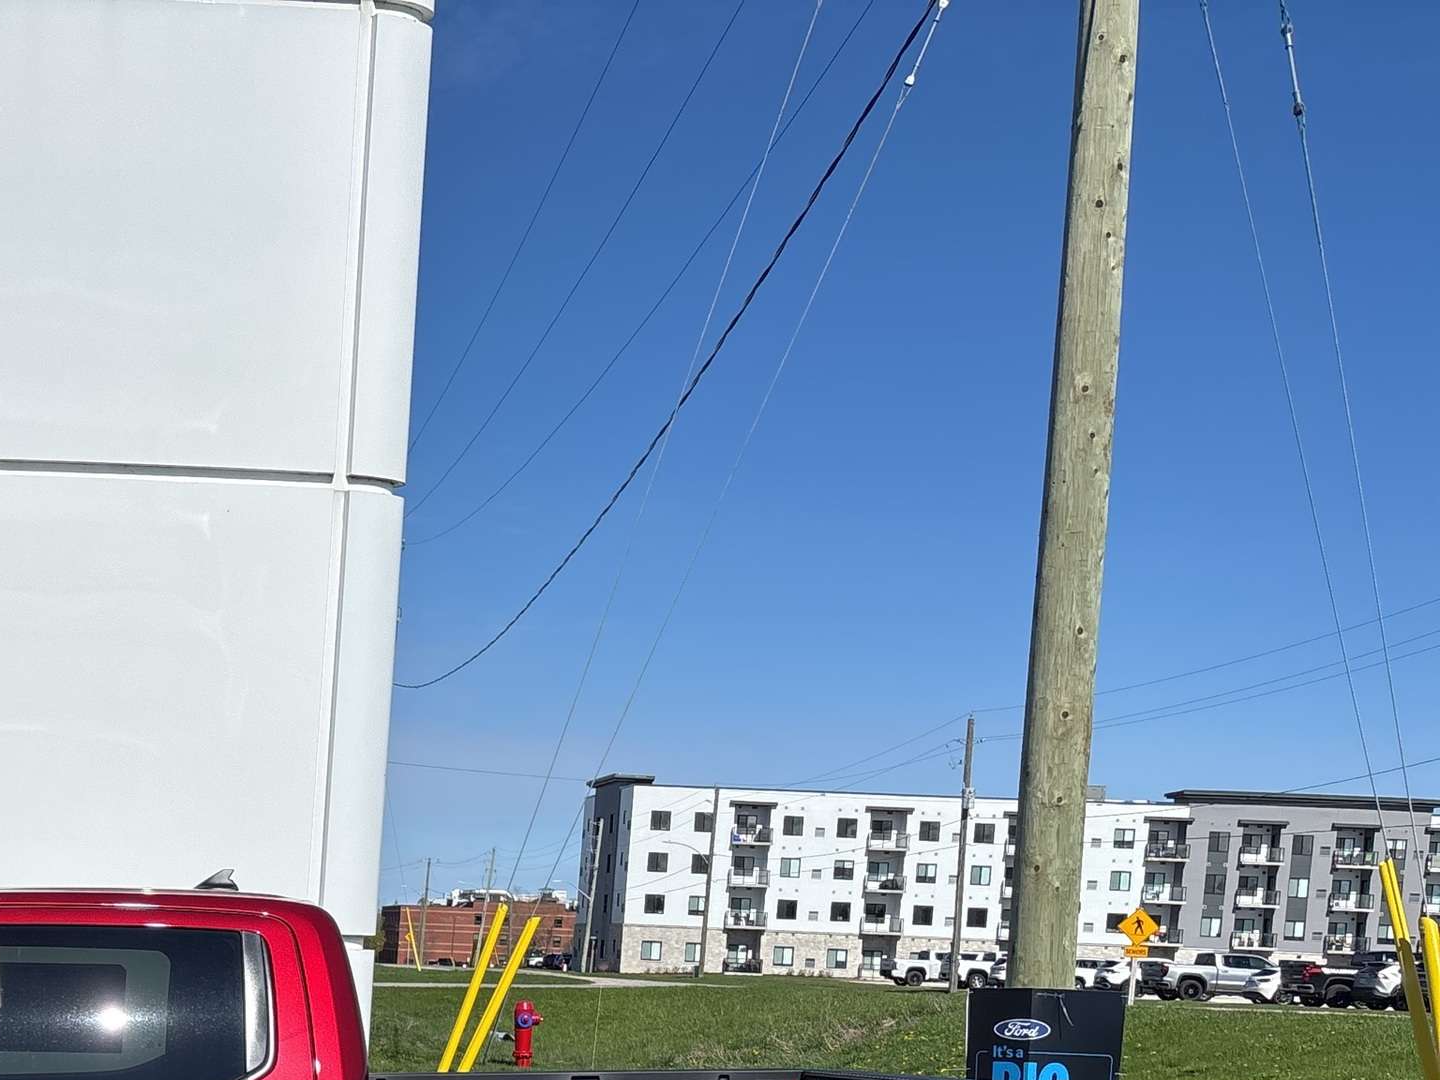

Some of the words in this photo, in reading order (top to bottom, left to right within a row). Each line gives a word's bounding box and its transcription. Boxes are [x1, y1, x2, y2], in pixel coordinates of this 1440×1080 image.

[1003, 1021, 1039, 1037] Ford
[992, 1045, 1014, 1058] It's
[1015, 1048, 1024, 1058] a
